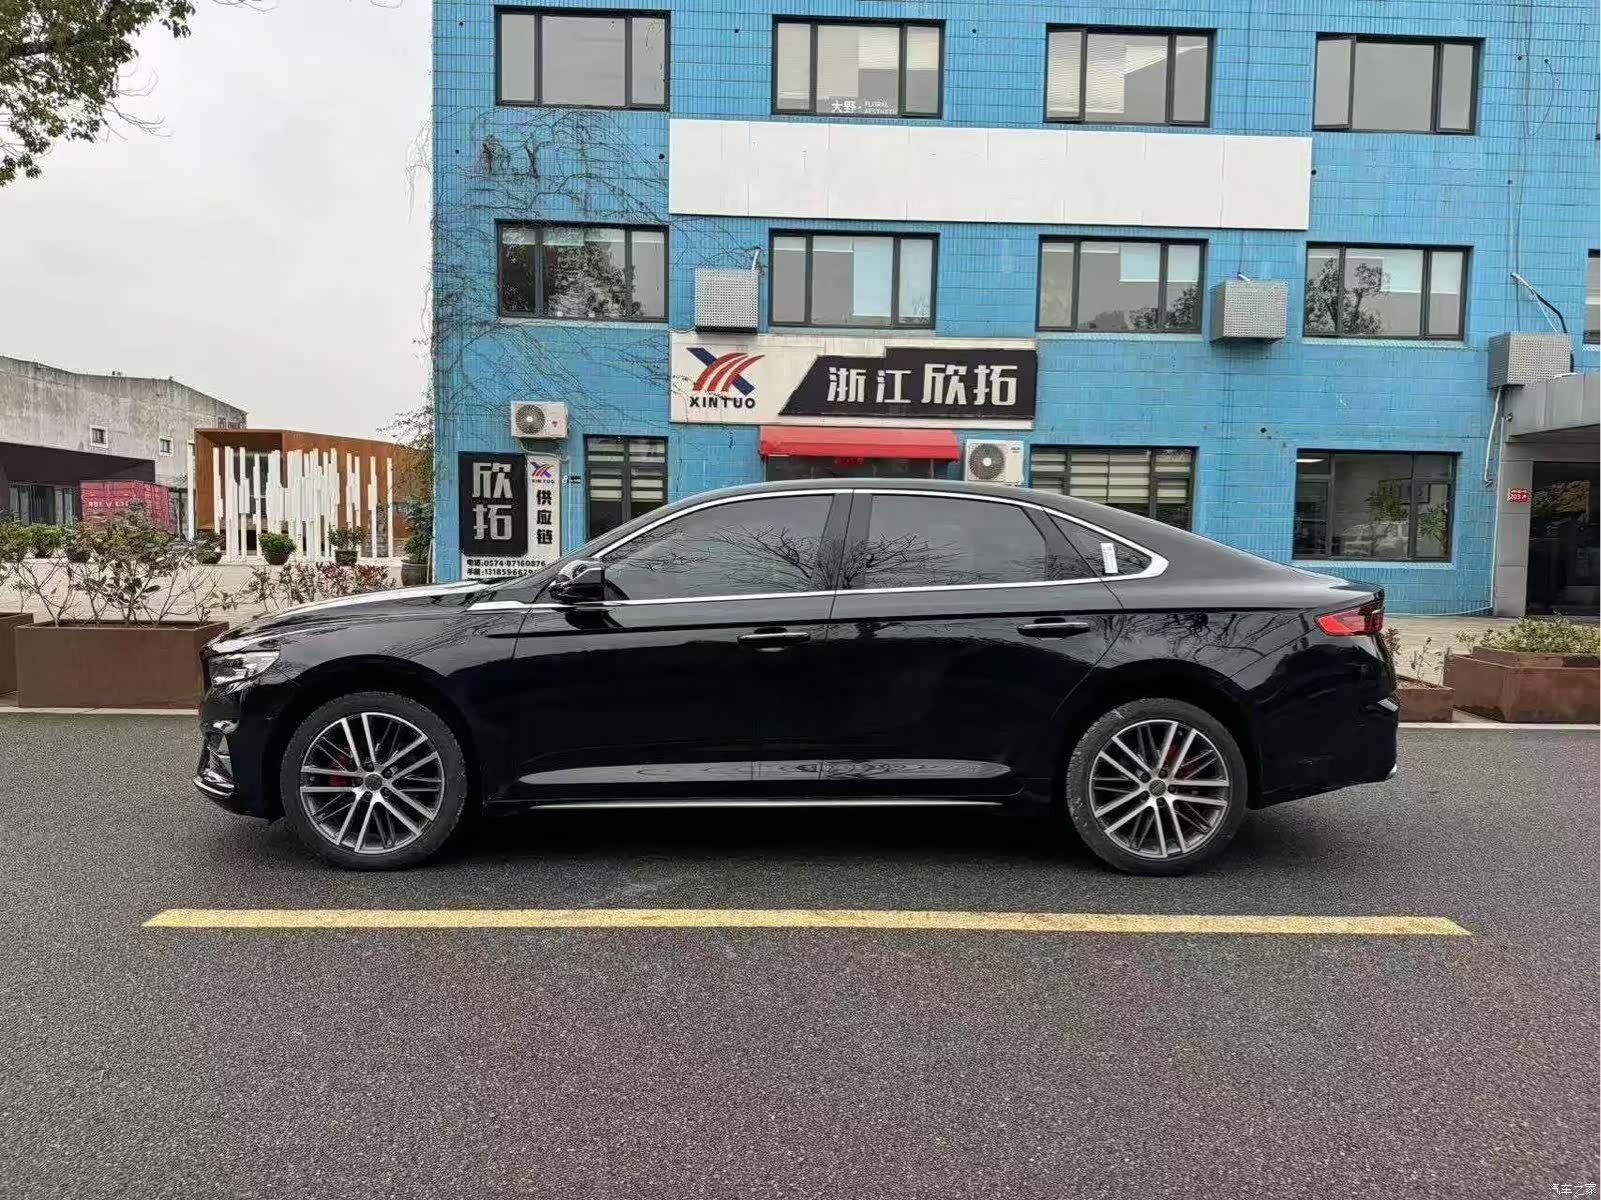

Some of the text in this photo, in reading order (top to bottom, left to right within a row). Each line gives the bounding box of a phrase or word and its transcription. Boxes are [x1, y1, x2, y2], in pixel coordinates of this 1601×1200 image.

[689, 395, 756, 409] XINTUO
[827, 363, 1018, 406] 浙江欣拓
[472, 462, 513, 540] 欣拓
[536, 489, 553, 544] 供应链
